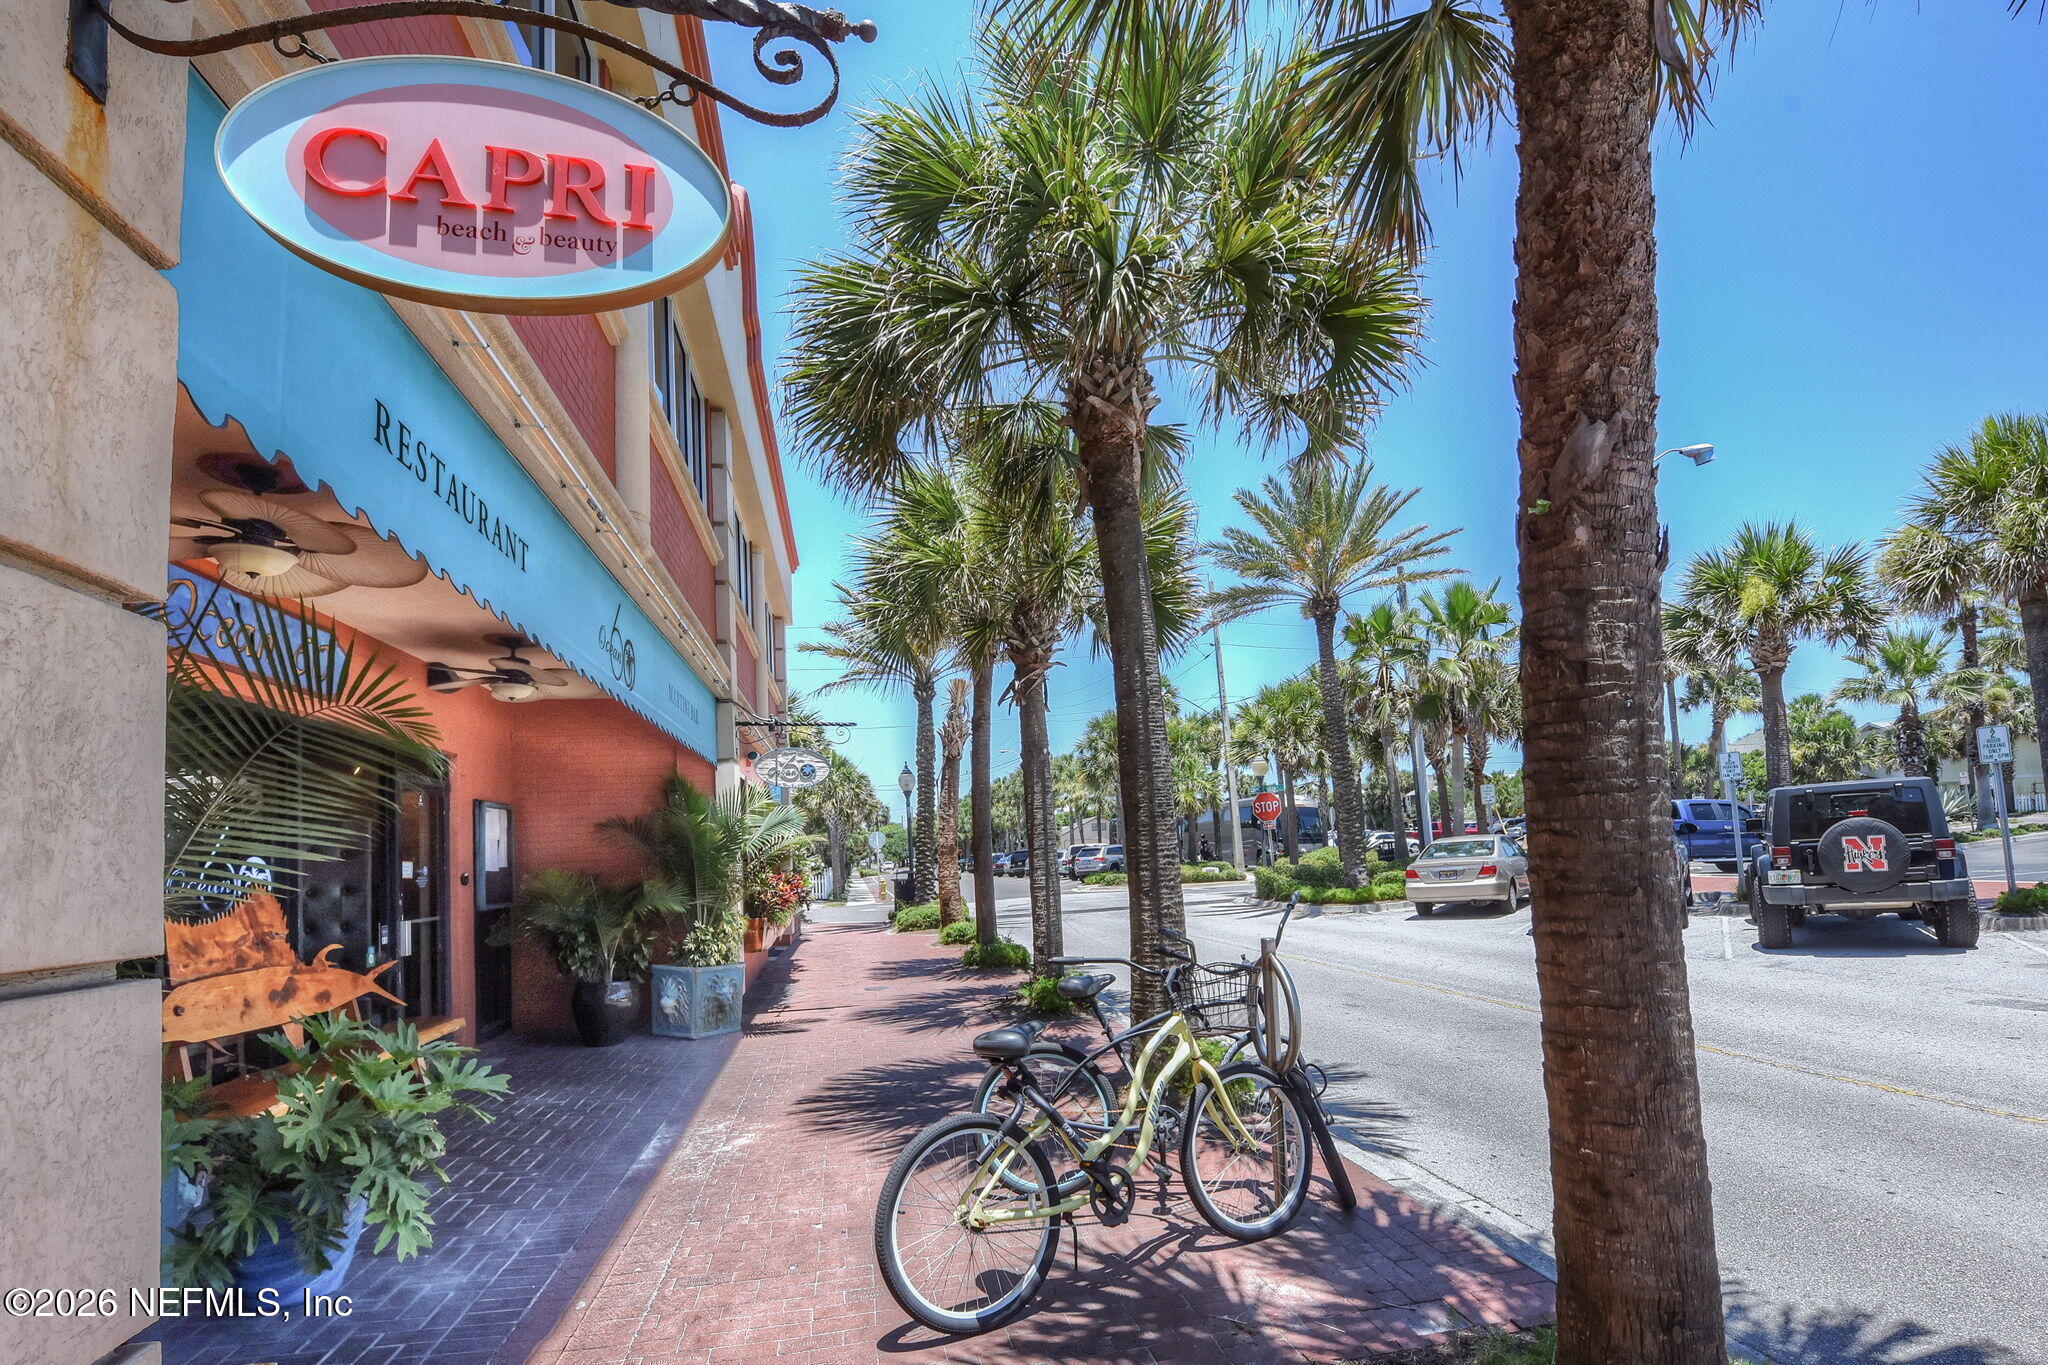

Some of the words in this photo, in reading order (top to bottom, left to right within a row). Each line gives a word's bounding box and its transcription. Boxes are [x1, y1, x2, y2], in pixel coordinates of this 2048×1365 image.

[303, 127, 655, 230] CAPRI
[437, 215, 507, 242] beach
[512, 234, 535, 255] &
[540, 226, 617, 257] beauty
[374, 398, 529, 573] RESTAURANT
[1982, 742, 2007, 750] PARKING
[1989, 729, 1996, 739] 2
[1255, 800, 1279, 813] STOP
